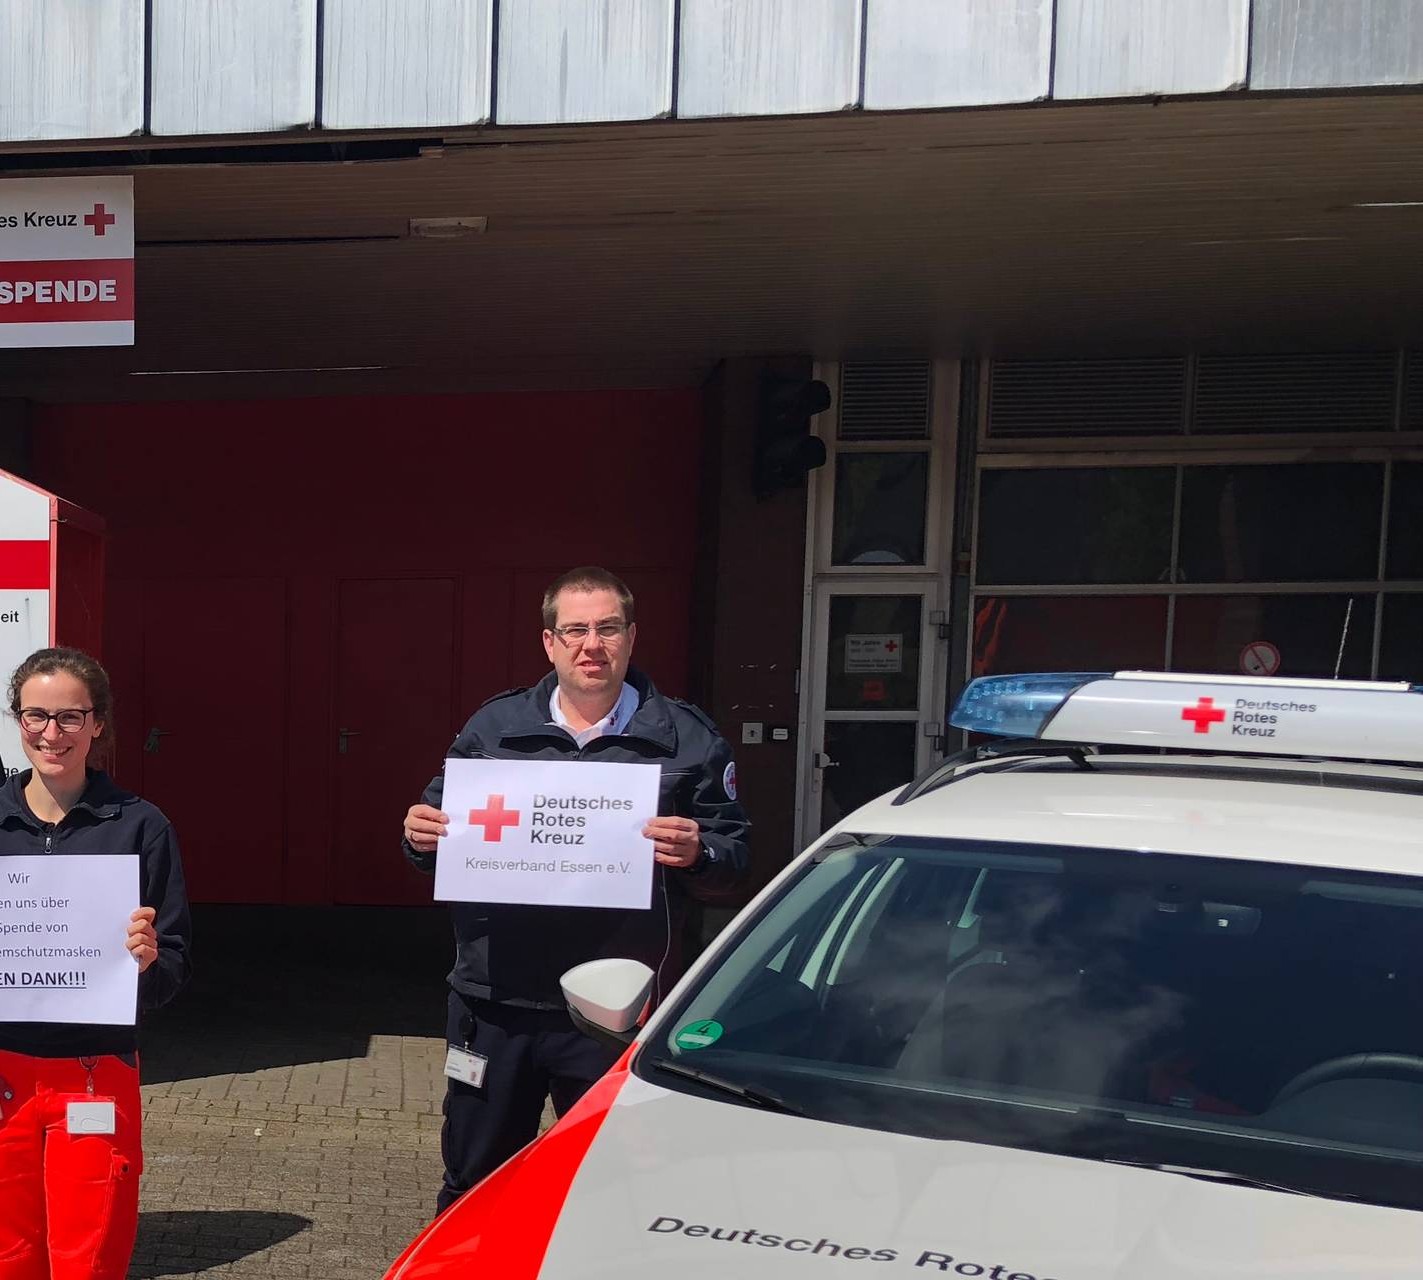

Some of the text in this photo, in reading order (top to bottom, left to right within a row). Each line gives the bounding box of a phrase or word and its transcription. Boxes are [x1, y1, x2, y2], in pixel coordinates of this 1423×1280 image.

[24, 211, 77, 228] Kreuz
[1235, 699, 1317, 713] Deutsches
[1233, 711, 1277, 724] Rotes
[1232, 724, 1275, 738] Kreuz
[533, 794, 633, 811] Deutsches
[531, 812, 586, 827] Rotes
[530, 829, 585, 846] Kreuz
[465, 857, 631, 875] Kreisverband Essen e.V.
[7, 872, 30, 884] Wir
[16, 899, 37, 909] uns
[41, 897, 69, 909] über
[46, 923, 68, 933] von
[22, 972, 86, 986] DANK!!!
[696, 1022, 713, 1035] 4
[647, 1216, 899, 1262] Deutsches
